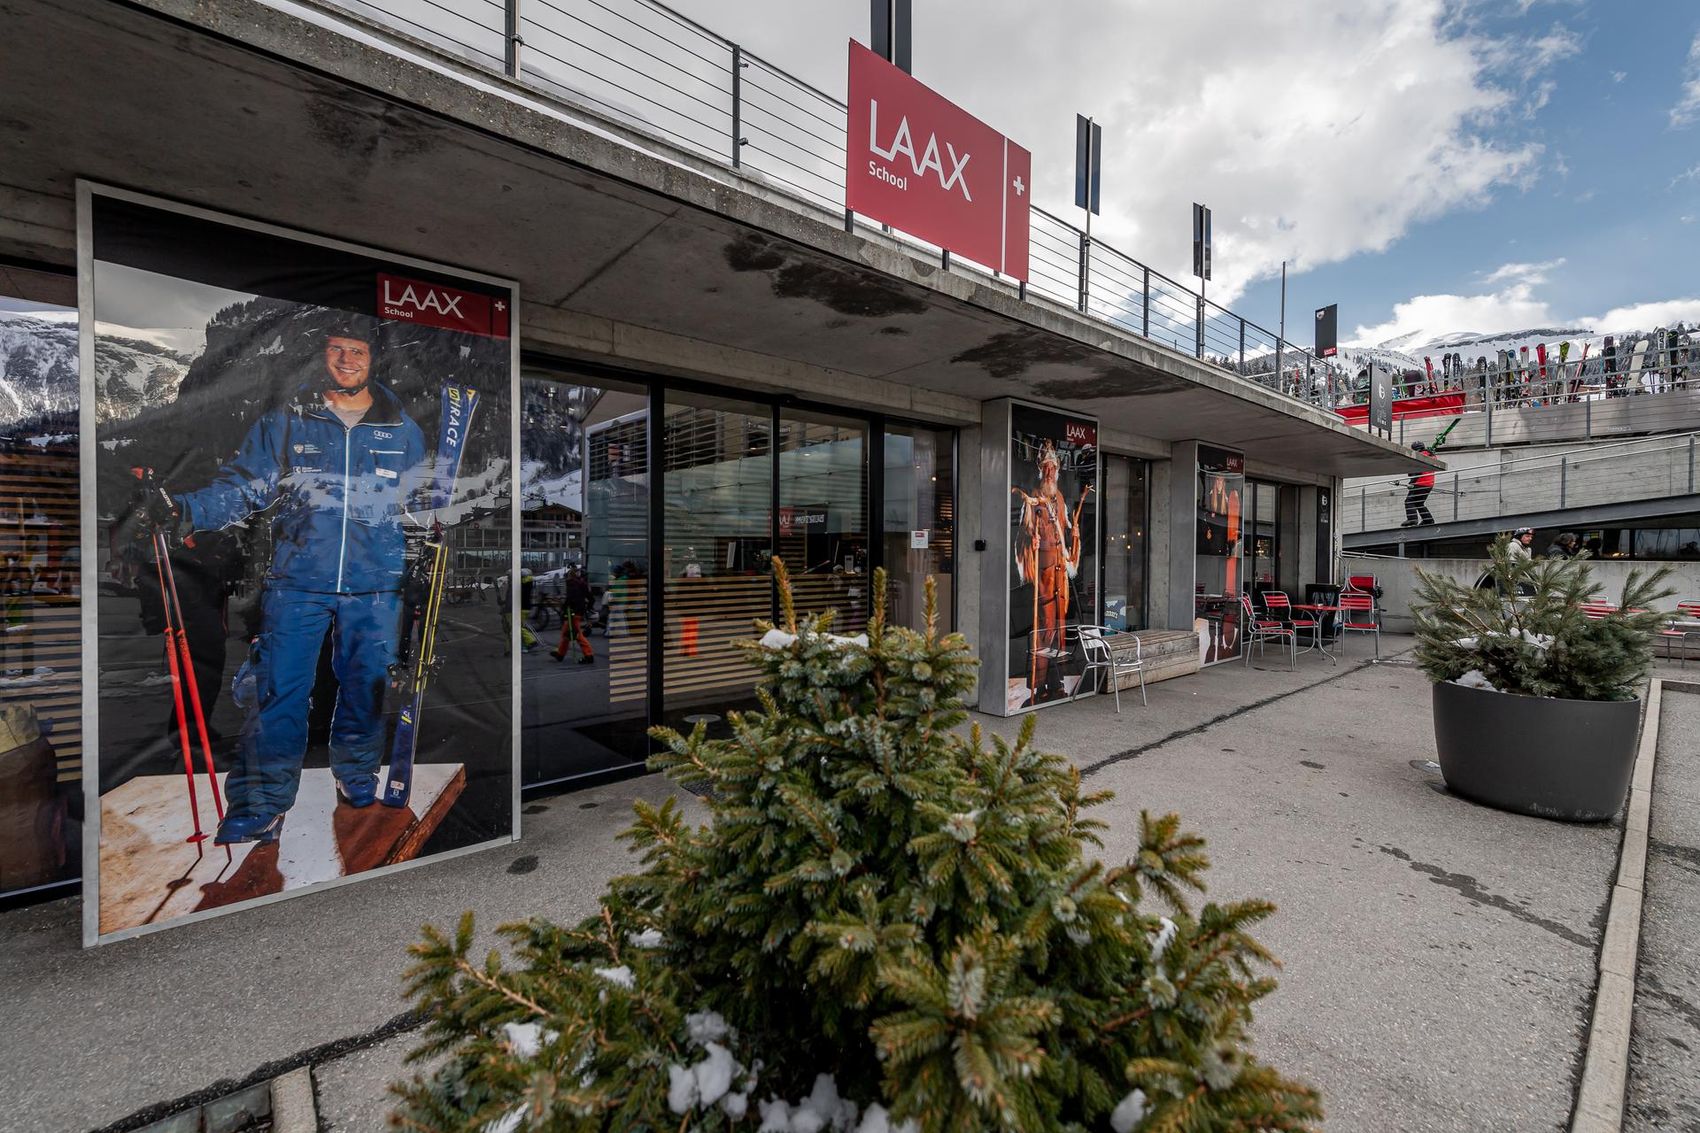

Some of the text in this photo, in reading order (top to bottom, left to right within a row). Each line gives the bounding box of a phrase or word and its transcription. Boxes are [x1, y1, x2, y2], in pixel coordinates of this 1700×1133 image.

[870, 98, 972, 202] LAAX
[869, 160, 907, 191] School
[384, 279, 464, 319] LAAX
[384, 306, 413, 319] School
[1066, 424, 1086, 440] LAAX
